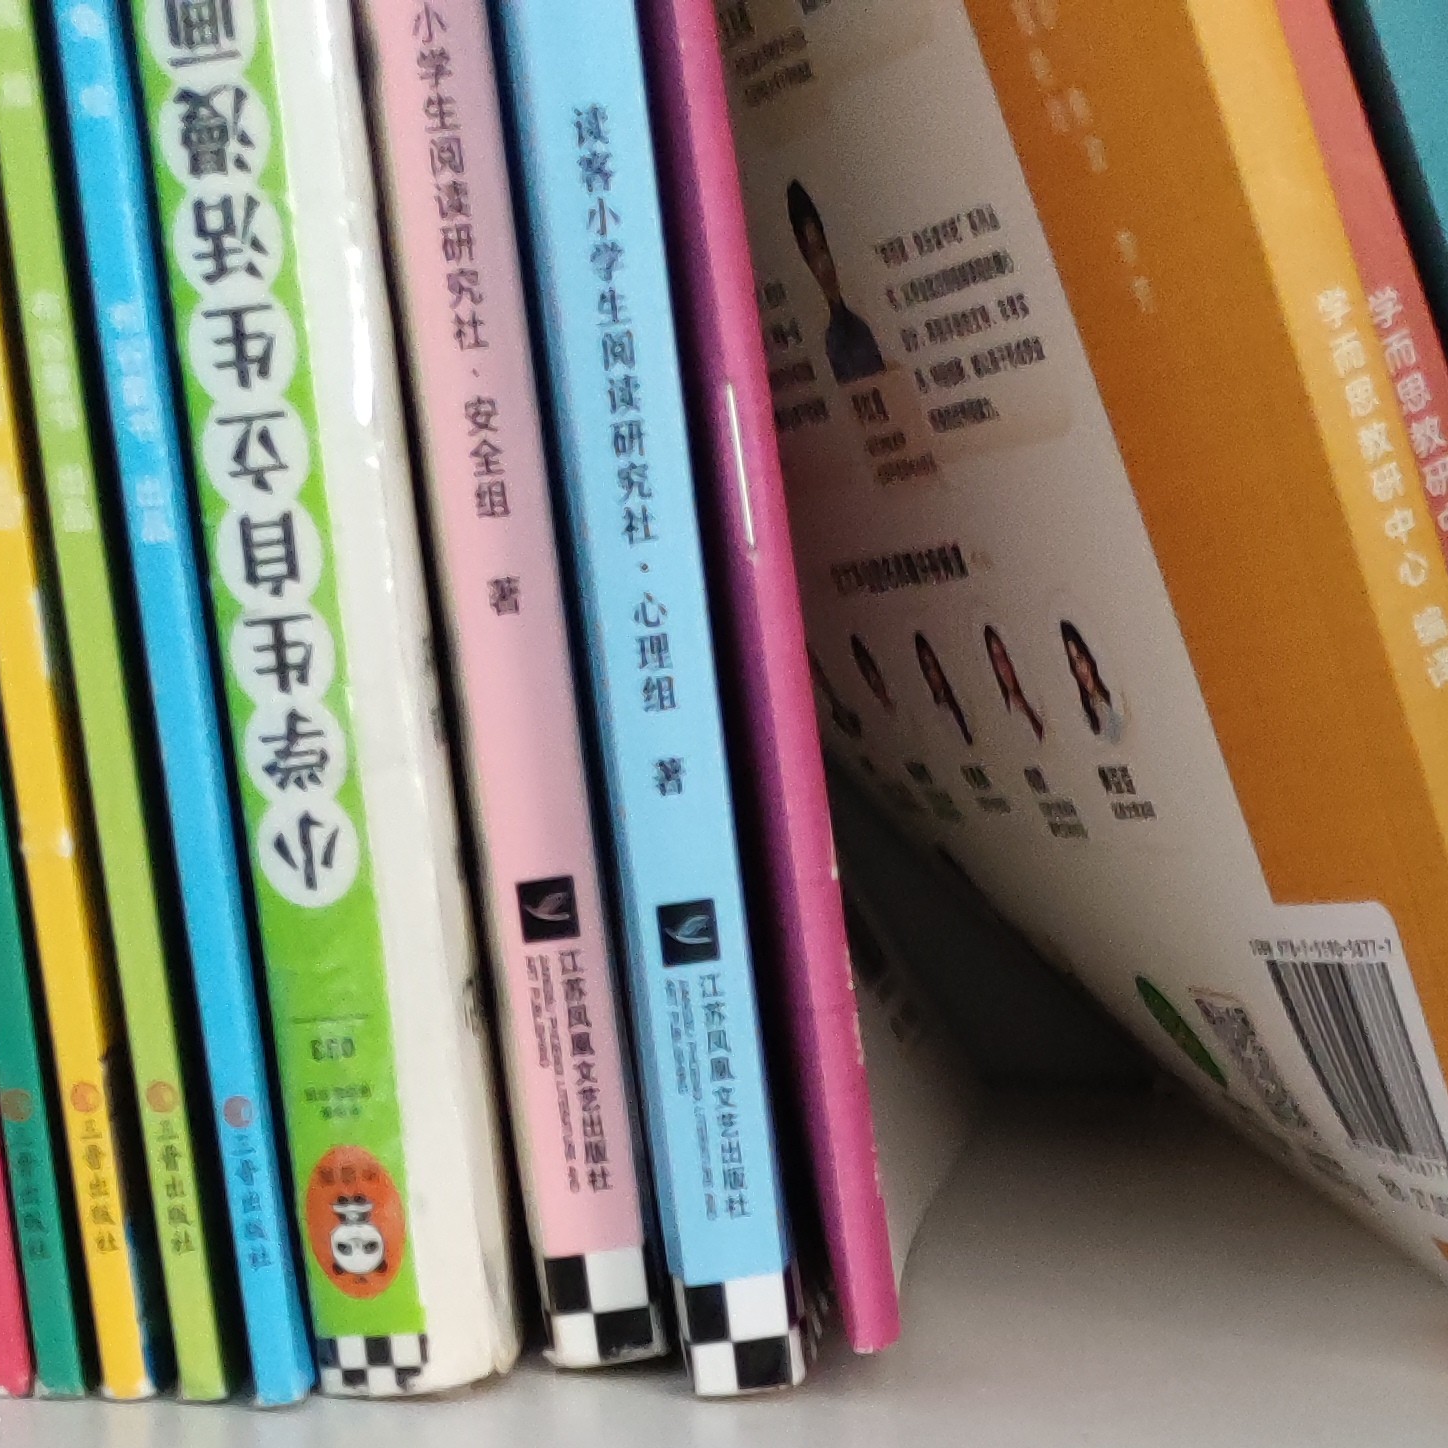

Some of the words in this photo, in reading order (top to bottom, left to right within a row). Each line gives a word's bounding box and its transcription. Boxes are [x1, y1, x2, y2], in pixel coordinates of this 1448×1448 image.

[1318, 285, 1429, 588] 学而思教研中心
